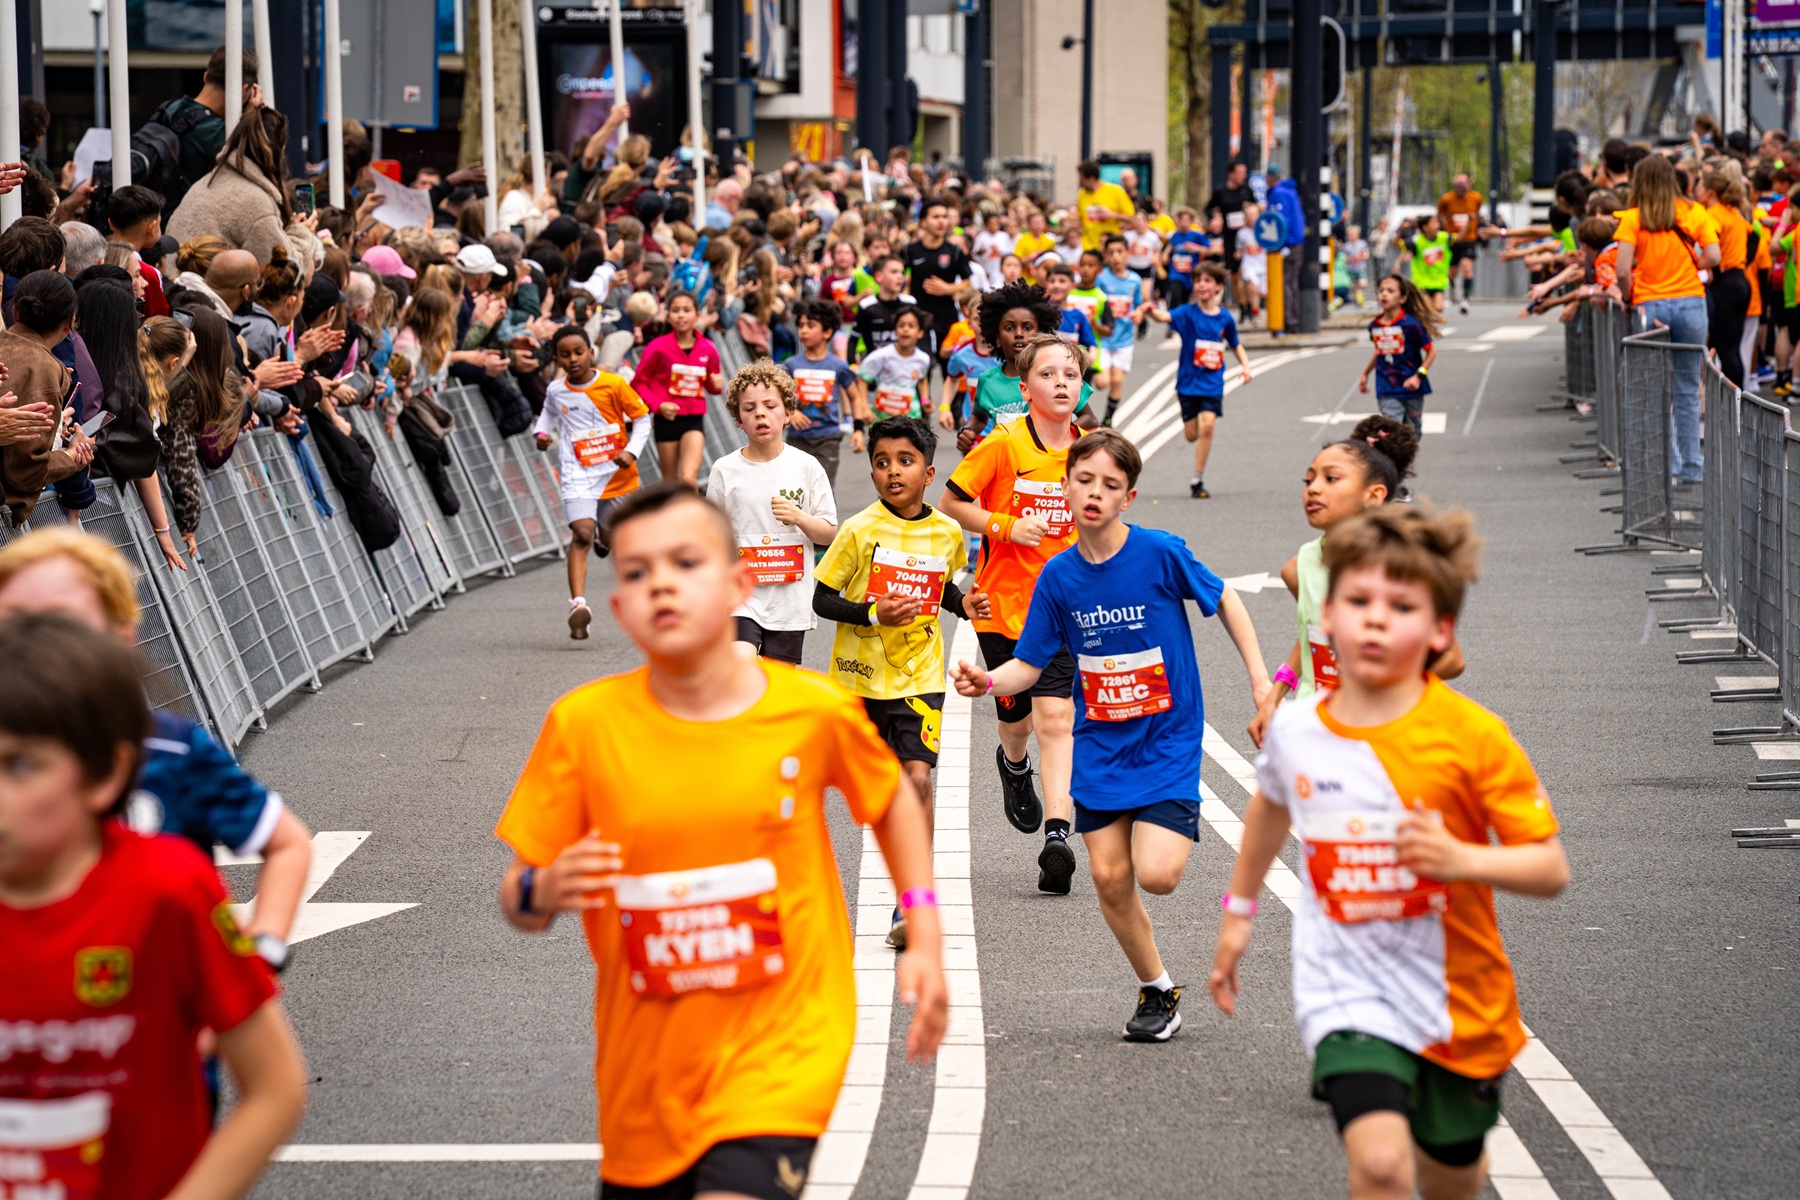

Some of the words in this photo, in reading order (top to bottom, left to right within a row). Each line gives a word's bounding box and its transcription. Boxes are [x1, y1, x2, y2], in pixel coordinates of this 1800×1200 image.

[1034, 498, 1066, 508] 70294
[1021, 506, 1073, 523] OWEN
[756, 549, 785, 557] 70556
[895, 570, 929, 584] 70446
[886, 580, 932, 599] VIRAJ
[1071, 604, 1146, 629] Harbour
[1100, 674, 1136, 687] 72861
[1097, 684, 1149, 704] ALEC
[1328, 867, 1417, 892] JULES
[645, 923, 754, 965] KYEN
